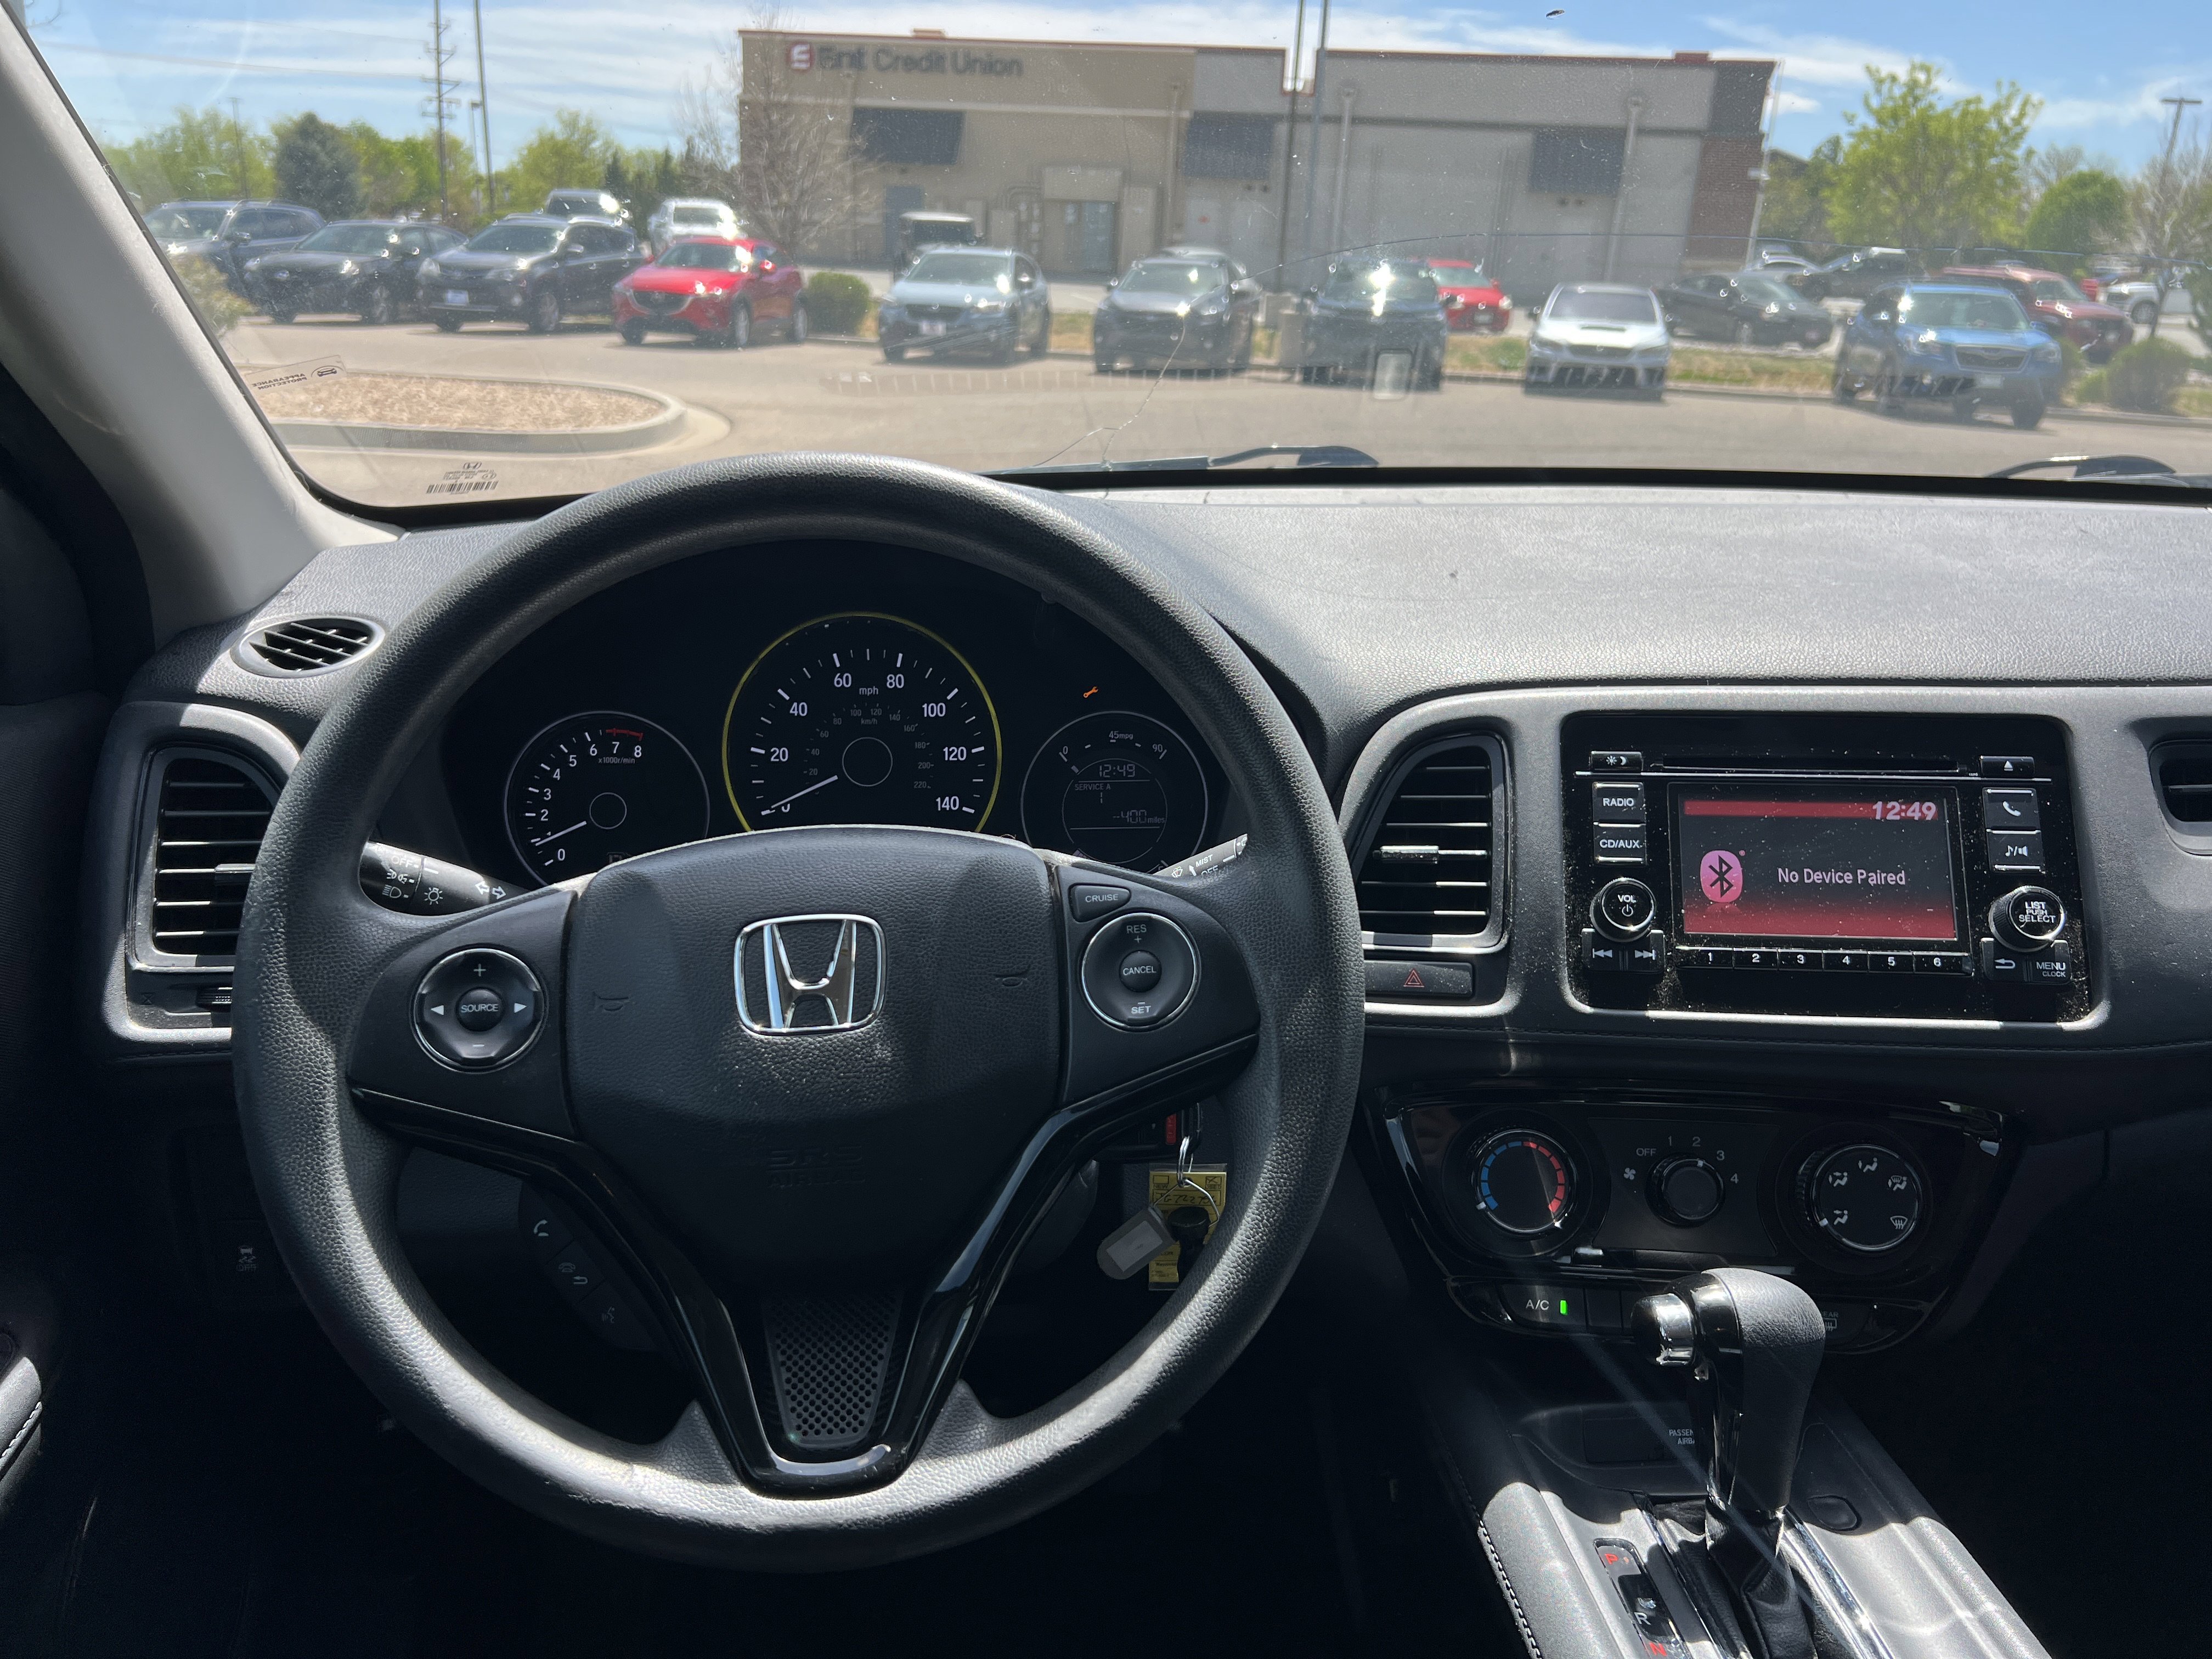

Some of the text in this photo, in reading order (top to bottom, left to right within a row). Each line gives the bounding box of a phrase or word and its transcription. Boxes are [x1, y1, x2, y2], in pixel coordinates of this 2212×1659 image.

[873, 48, 947, 74] Credit
[950, 50, 1023, 76] Union
[834, 673, 851, 687] 60
[887, 674, 904, 688] 80
[860, 686, 878, 696] mph
[790, 702, 807, 716] 40
[922, 703, 945, 717] 100
[890, 713, 900, 721] 140
[590, 744, 597, 755] 6
[612, 742, 619, 753] 7
[634, 746, 641, 757] 8
[1063, 746, 1068, 754] 0
[1153, 744, 1163, 753] 90
[771, 748, 788, 761] 20
[944, 747, 966, 760] 120
[569, 755, 577, 766] 5
[553, 769, 560, 780] 4
[1099, 764, 1135, 777] 12:49
[544, 788, 551, 800] 3
[936, 796, 959, 810] 140
[1602, 798, 1634, 806] RADIO
[541, 809, 548, 821] 2
[1872, 801, 1937, 821] 12:49
[1599, 839, 1639, 849] CD/AUX
[558, 849, 565, 860] 0
[391, 855, 413, 867] OFF
[1195, 854, 1213, 867] MIST
[1779, 868, 1905, 885] No Device Paired
[1085, 894, 1119, 902] CRUISE
[1618, 895, 1636, 903] VOL
[2018, 915, 2056, 923] SELECT
[1127, 924, 1147, 933] RES
[1708, 952, 1712, 961] 1
[1752, 953, 1759, 962] 2
[1797, 955, 1804, 963] 3
[1843, 956, 1850, 964] 4
[1888, 957, 1895, 966] 5
[1934, 958, 1941, 966] 6
[1123, 966, 1155, 975] CANCEL
[461, 1004, 498, 1013] SOURCE
[1131, 1006, 1151, 1014] SET
[1668, 1136, 1672, 1146] 1
[1692, 1137, 1700, 1147] 2
[1717, 1150, 1724, 1160] 3
[1731, 1173, 1739, 1183] 4
[1527, 1300, 1549, 1310] A/C
[1604, 1553, 1619, 1565] P
[1634, 1612, 1652, 1625] R
[1649, 1641, 1668, 1657] N
